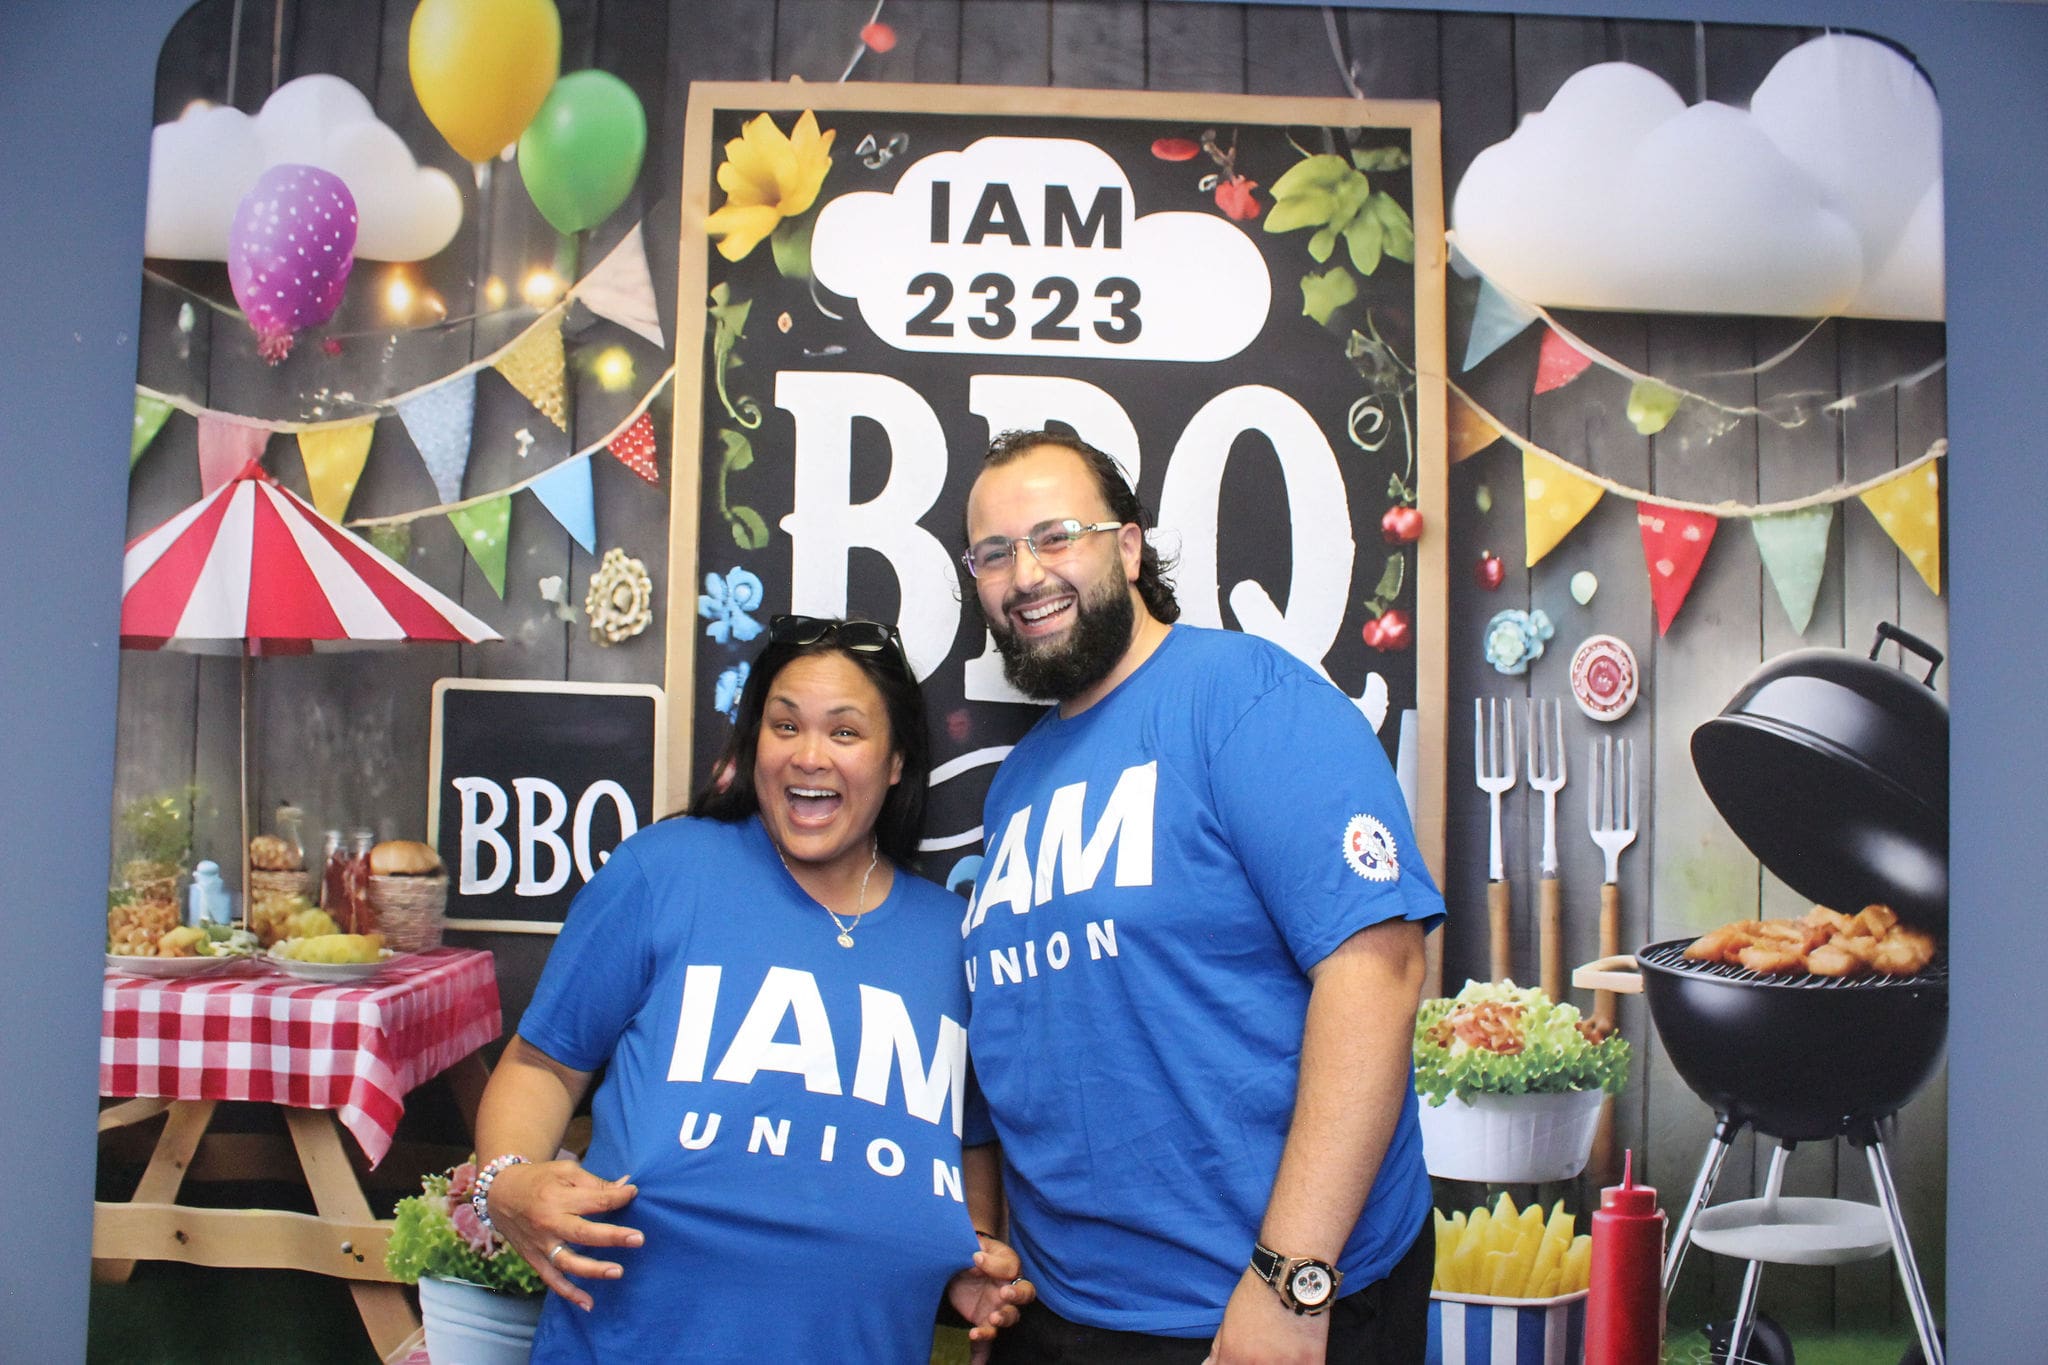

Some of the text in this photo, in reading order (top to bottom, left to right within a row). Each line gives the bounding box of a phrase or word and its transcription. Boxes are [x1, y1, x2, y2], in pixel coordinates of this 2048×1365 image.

[931, 181, 1122, 249] IAM
[906, 272, 1142, 344] 2323
[452, 776, 638, 896] BBQ
[965, 919, 1119, 992] UNION
[666, 965, 967, 1140] IAM
[679, 1111, 964, 1203] UNION
